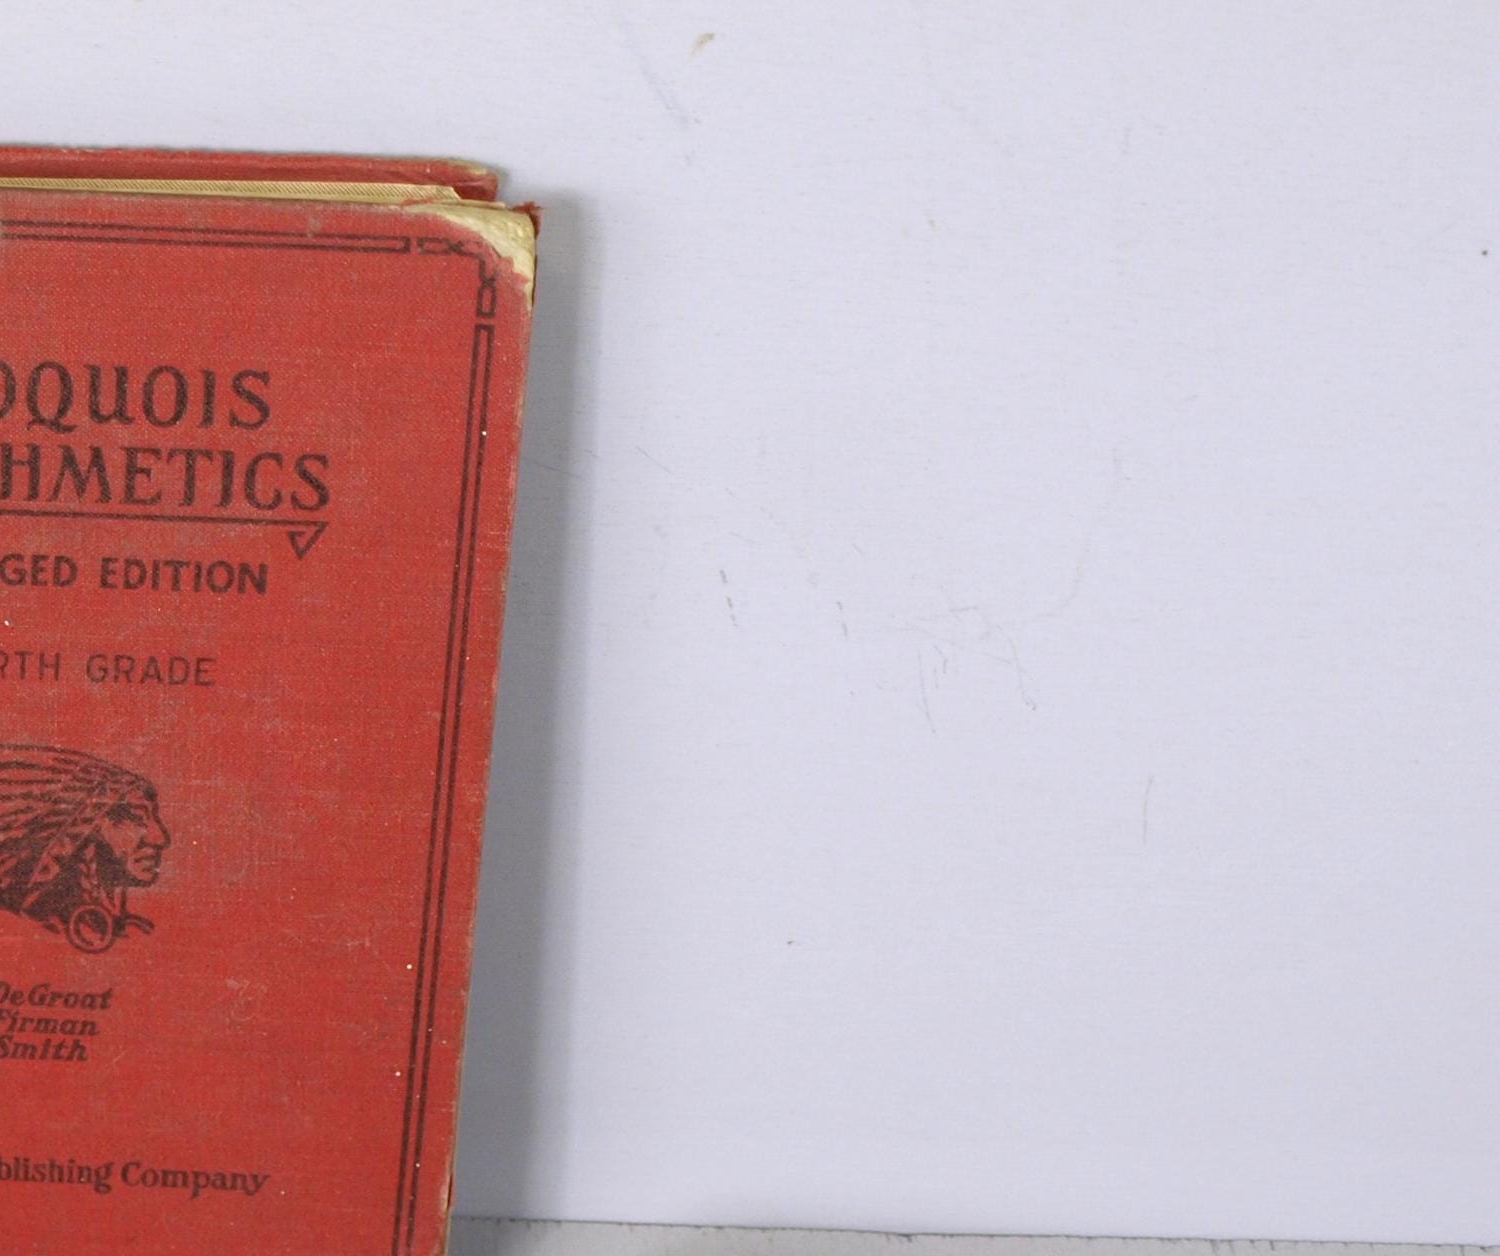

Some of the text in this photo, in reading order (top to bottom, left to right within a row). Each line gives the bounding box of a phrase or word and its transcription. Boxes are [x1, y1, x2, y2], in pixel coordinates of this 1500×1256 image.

[100, 556, 268, 595] EDITION
[86, 654, 216, 687] GRADE
[121, 1161, 270, 1200] Company
